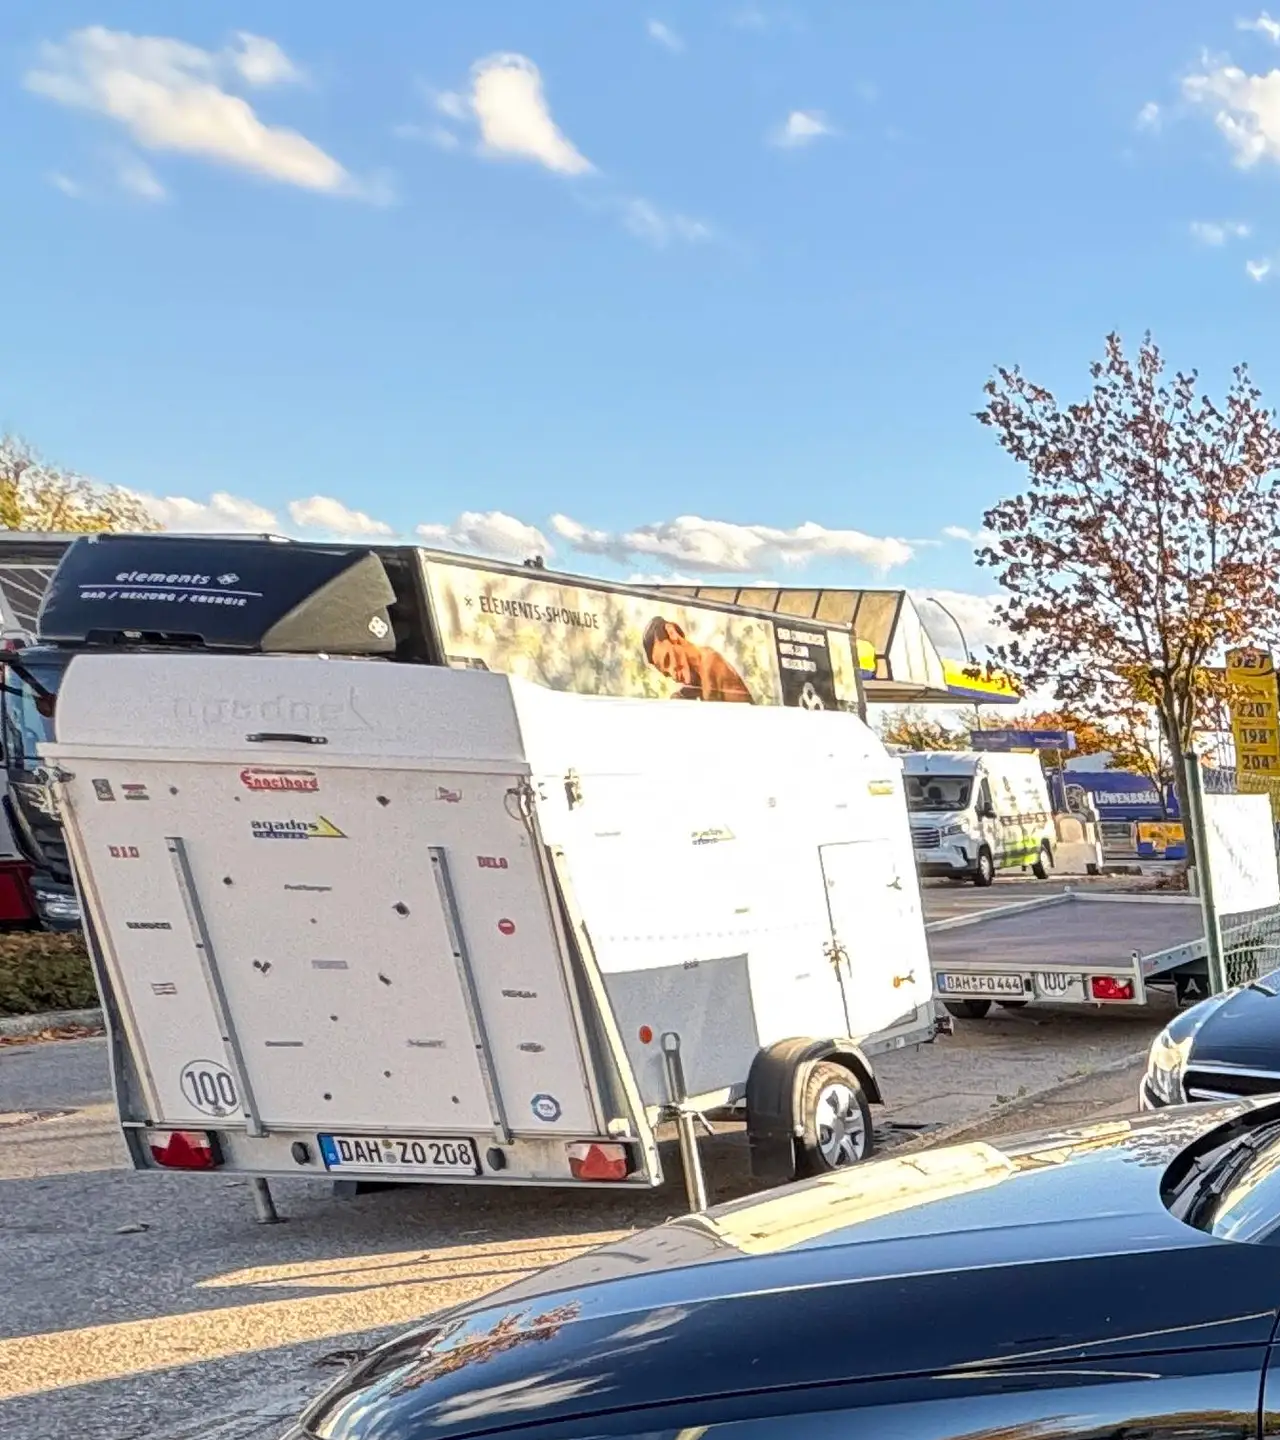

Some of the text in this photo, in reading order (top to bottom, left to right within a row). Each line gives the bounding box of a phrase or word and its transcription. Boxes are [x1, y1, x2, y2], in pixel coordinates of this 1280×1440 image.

[115, 570, 211, 585] elements
[478, 595, 600, 630] ELEMENTS-SHOW.DE
[947, 975, 970, 990] DAH
[997, 977, 1019, 990] 444
[185, 1071, 237, 1107] 100
[337, 1139, 472, 1166] DAH ZO 208
